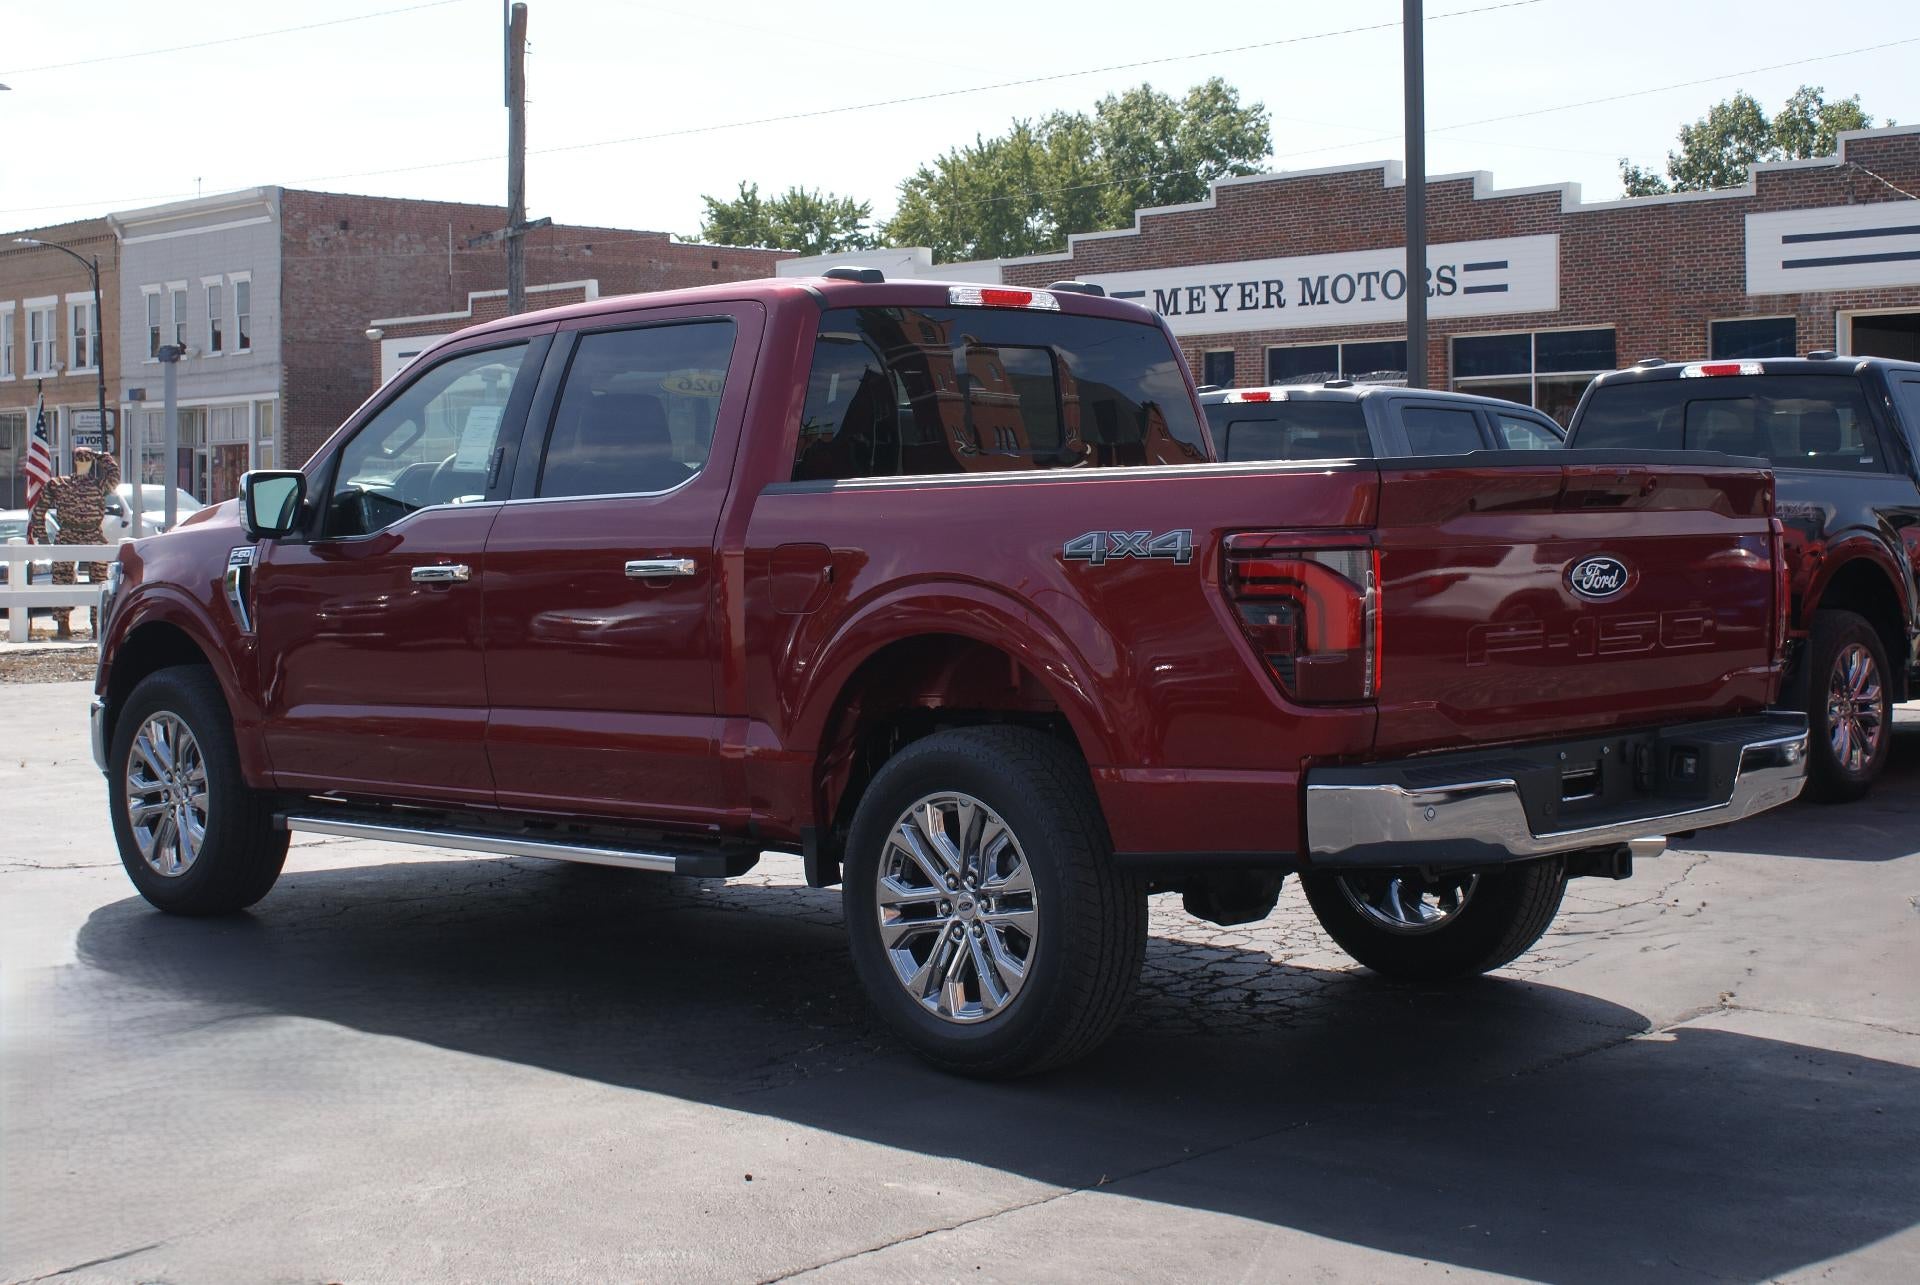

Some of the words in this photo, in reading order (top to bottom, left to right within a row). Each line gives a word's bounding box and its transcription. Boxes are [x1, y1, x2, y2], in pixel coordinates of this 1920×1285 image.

[1153, 279, 1287, 317] MEYER
[1582, 563, 1619, 590] Ford
[1466, 607, 1719, 668] F-150
